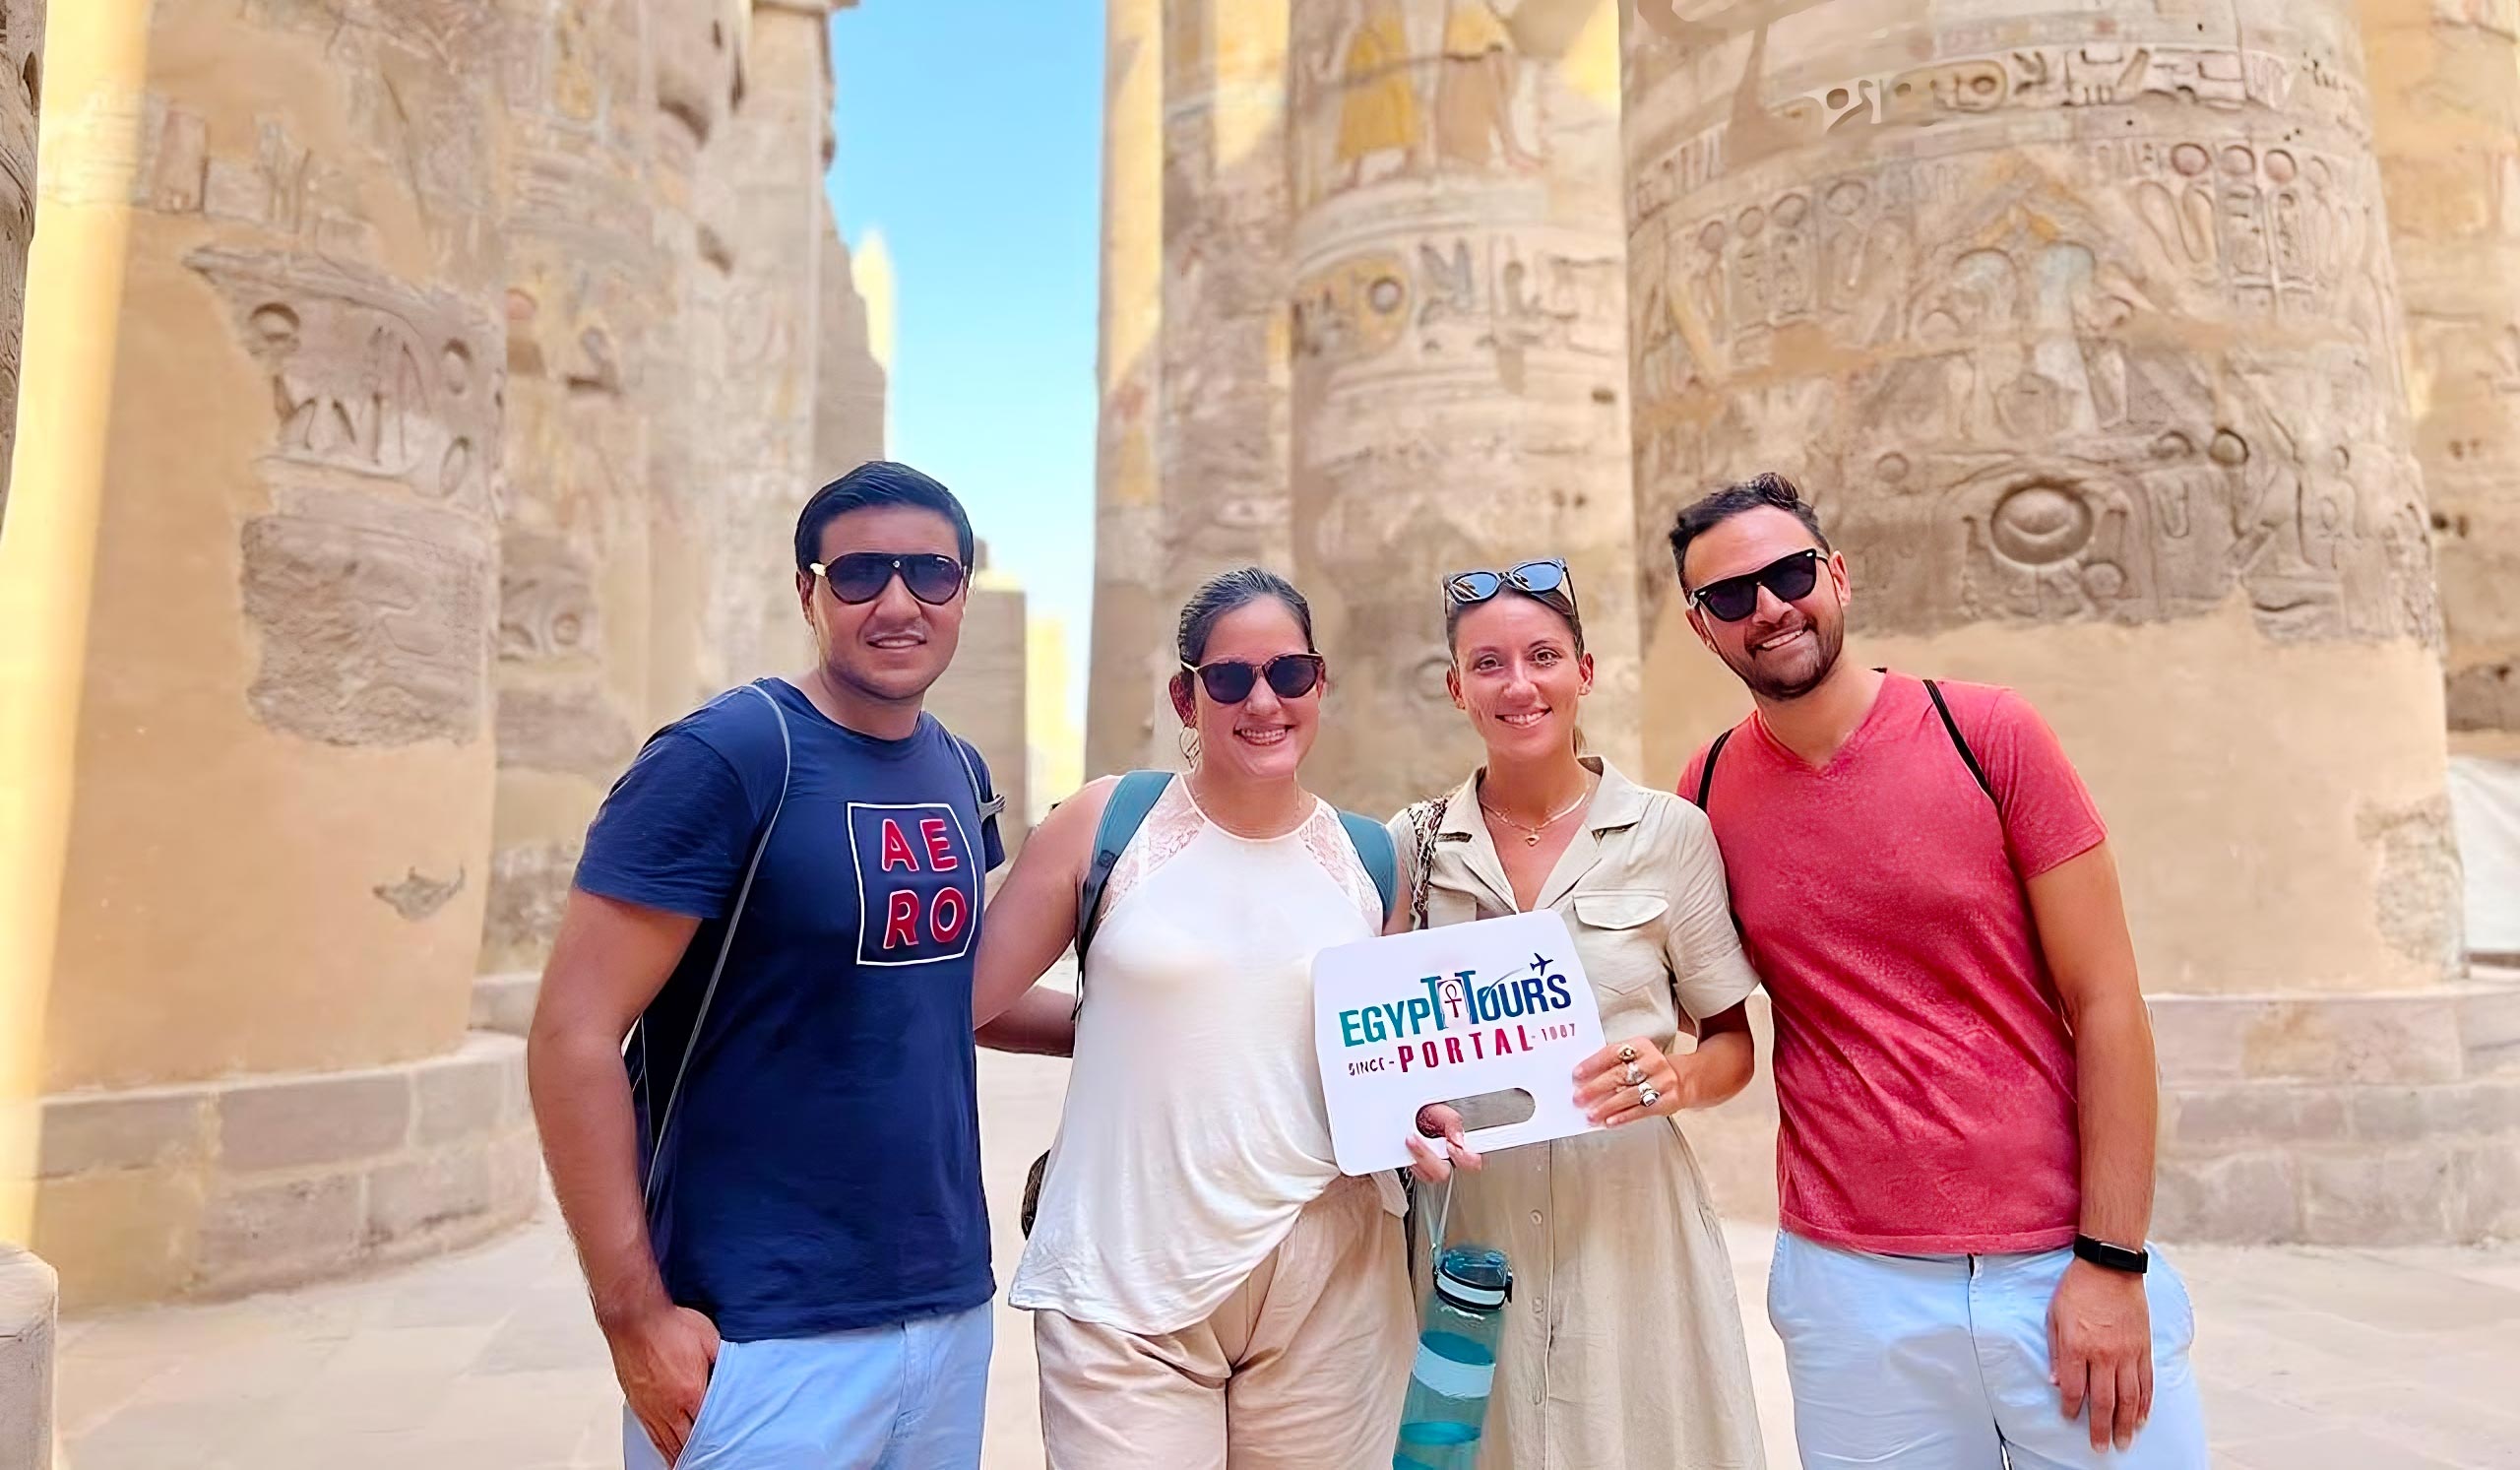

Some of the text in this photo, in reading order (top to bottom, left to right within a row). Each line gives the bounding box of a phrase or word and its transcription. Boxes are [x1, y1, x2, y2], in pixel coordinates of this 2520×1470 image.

[882, 819, 958, 871] AE
[883, 887, 967, 949] RO
[1339, 970, 1572, 1047] EGYPT TOURS
[1398, 1025, 1534, 1072] PORTAL
